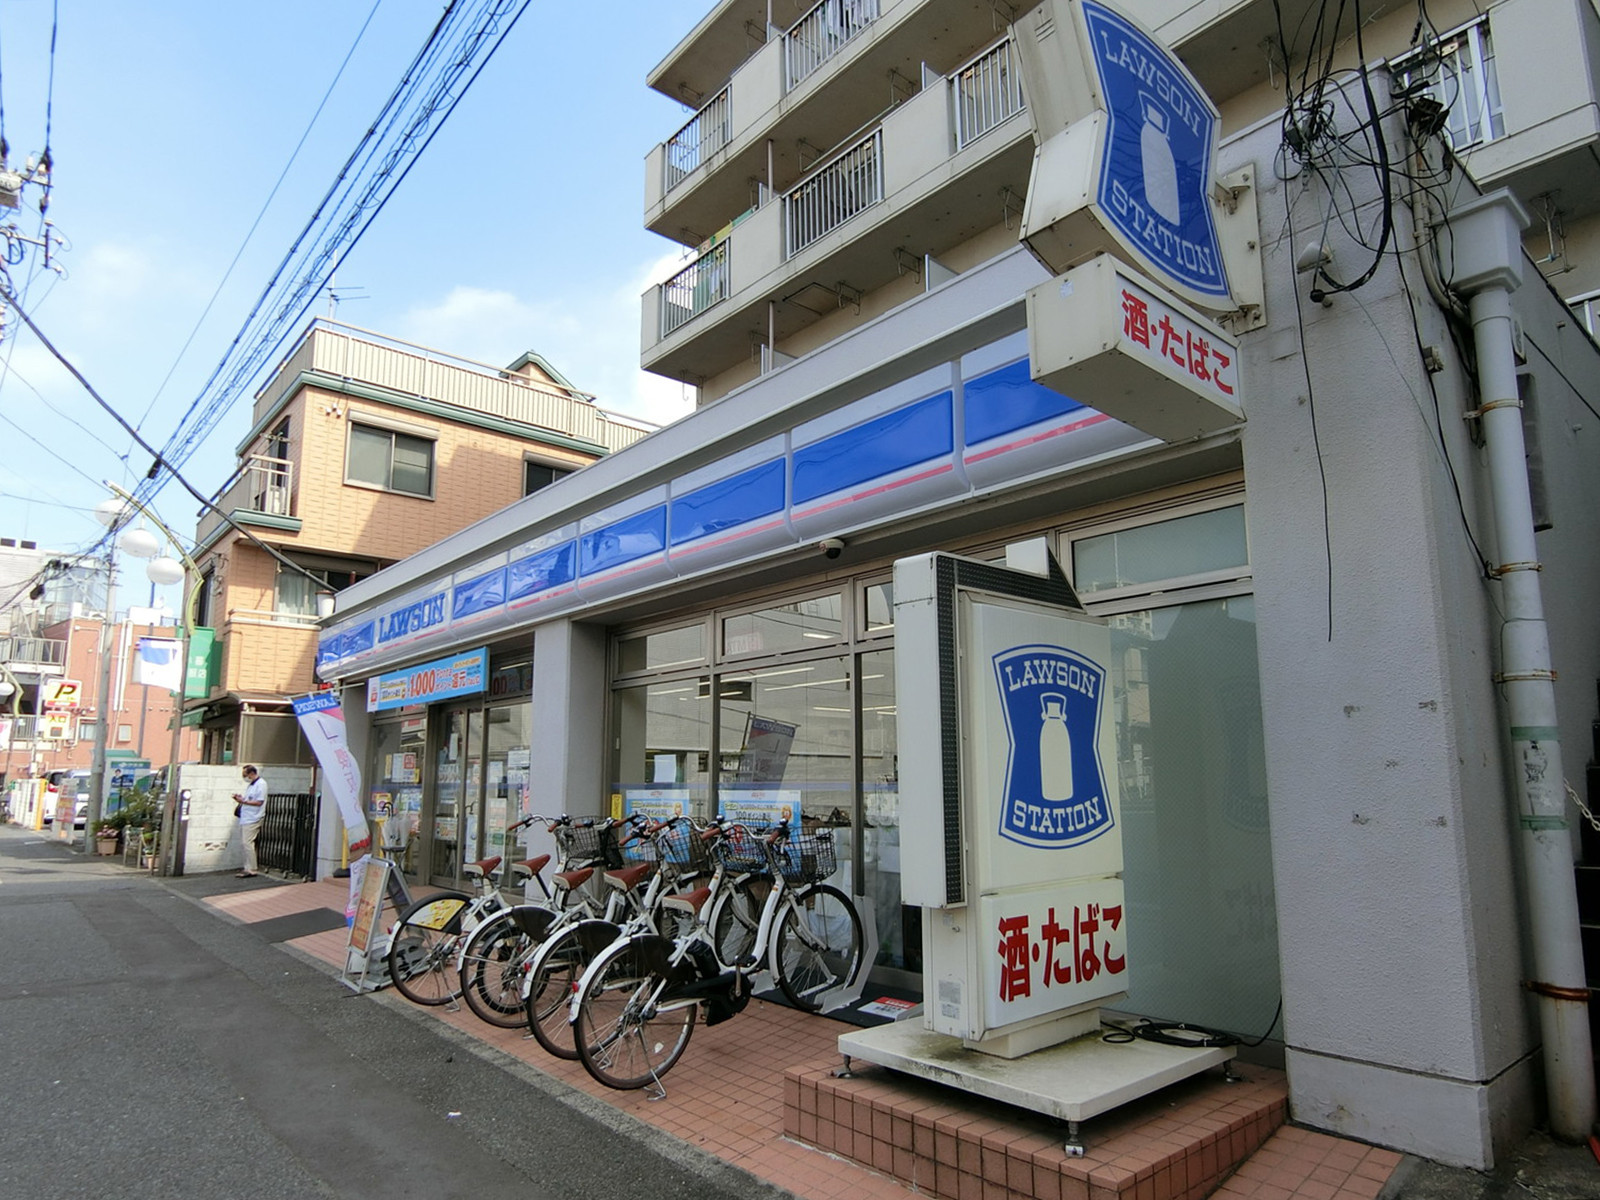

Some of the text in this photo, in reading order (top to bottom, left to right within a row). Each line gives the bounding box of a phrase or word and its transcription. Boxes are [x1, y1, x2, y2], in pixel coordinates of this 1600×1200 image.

[1101, 30, 1200, 138] LAWSON
[1112, 179, 1215, 277] STATION
[1121, 289, 1234, 396] 酒・たばこ
[378, 592, 446, 644] LAWSON
[54, 683, 77, 699] P
[1005, 660, 1097, 699] LAWSON
[1013, 797, 1102, 833] STATION
[998, 903, 1126, 1003] 酒・たばこ
